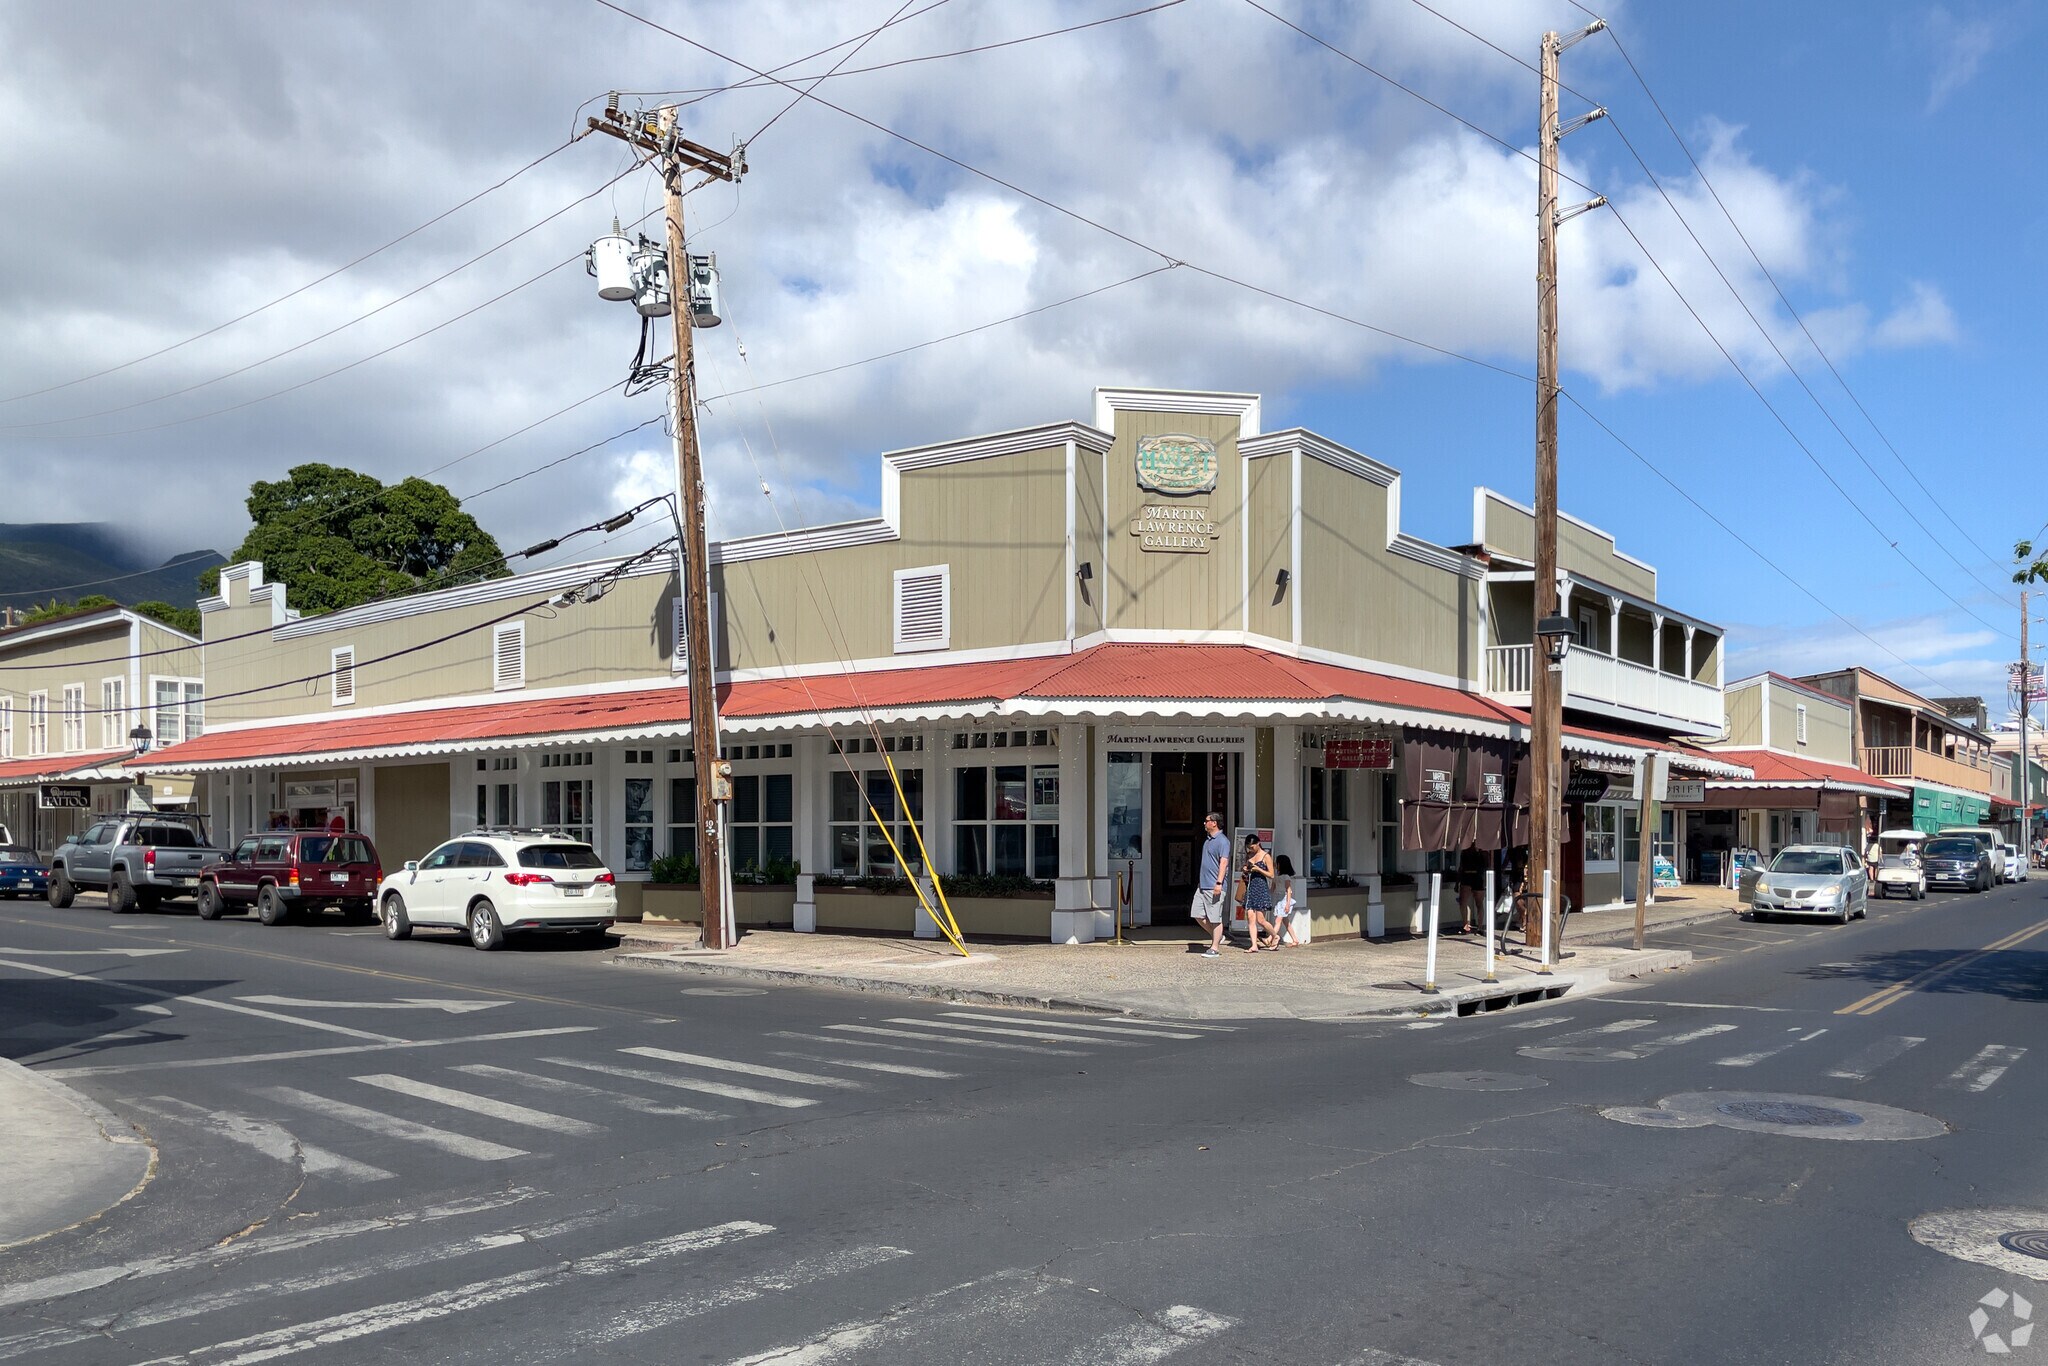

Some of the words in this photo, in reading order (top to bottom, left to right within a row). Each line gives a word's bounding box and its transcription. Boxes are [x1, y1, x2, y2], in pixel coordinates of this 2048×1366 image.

[1141, 449, 1213, 473] MARKET
[1146, 507, 1205, 520] MARTIN
[1138, 521, 1214, 534] LAWRENCE
[1145, 536, 1206, 548] GALLERY
[1197, 735, 1245, 744] GALLERIES
[1570, 773, 1600, 788] glass
[44, 796, 88, 806] TATTOO
